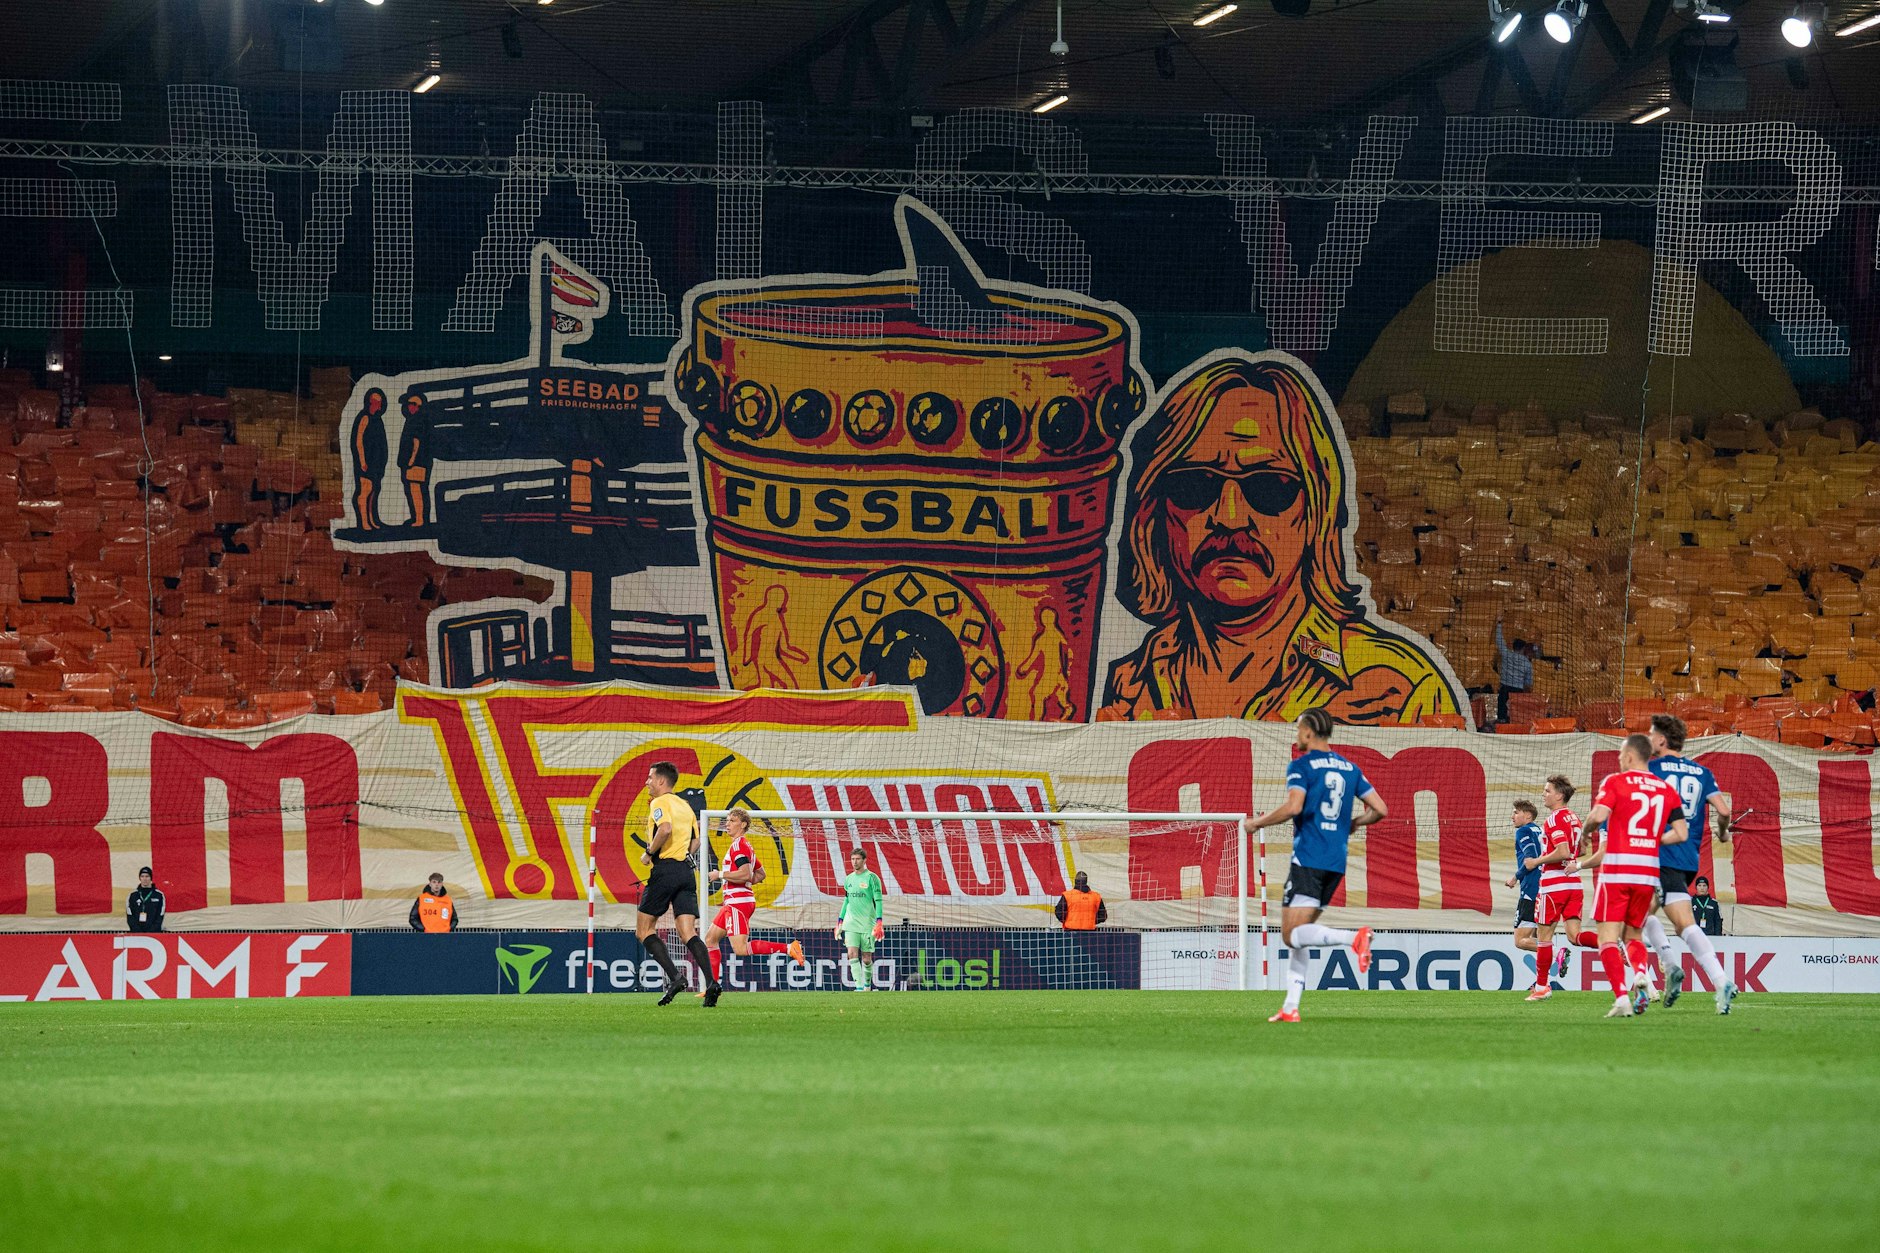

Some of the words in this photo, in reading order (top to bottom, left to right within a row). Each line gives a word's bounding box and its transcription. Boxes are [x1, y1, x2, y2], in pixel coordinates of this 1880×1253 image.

[1203, 113, 1880, 357] VER
[540, 378, 639, 401] SEEBAD
[541, 399, 637, 410] FRIEDRICHSHAGEN
[724, 476, 1084, 538] FUSSBALL
[1320, 770, 1346, 820] 3
[1627, 792, 1665, 837] 21
[787, 783, 1067, 897] UNION
[565, 949, 756, 992] freent,
[766, 952, 907, 991] fertg,
[918, 949, 1000, 988] los!
